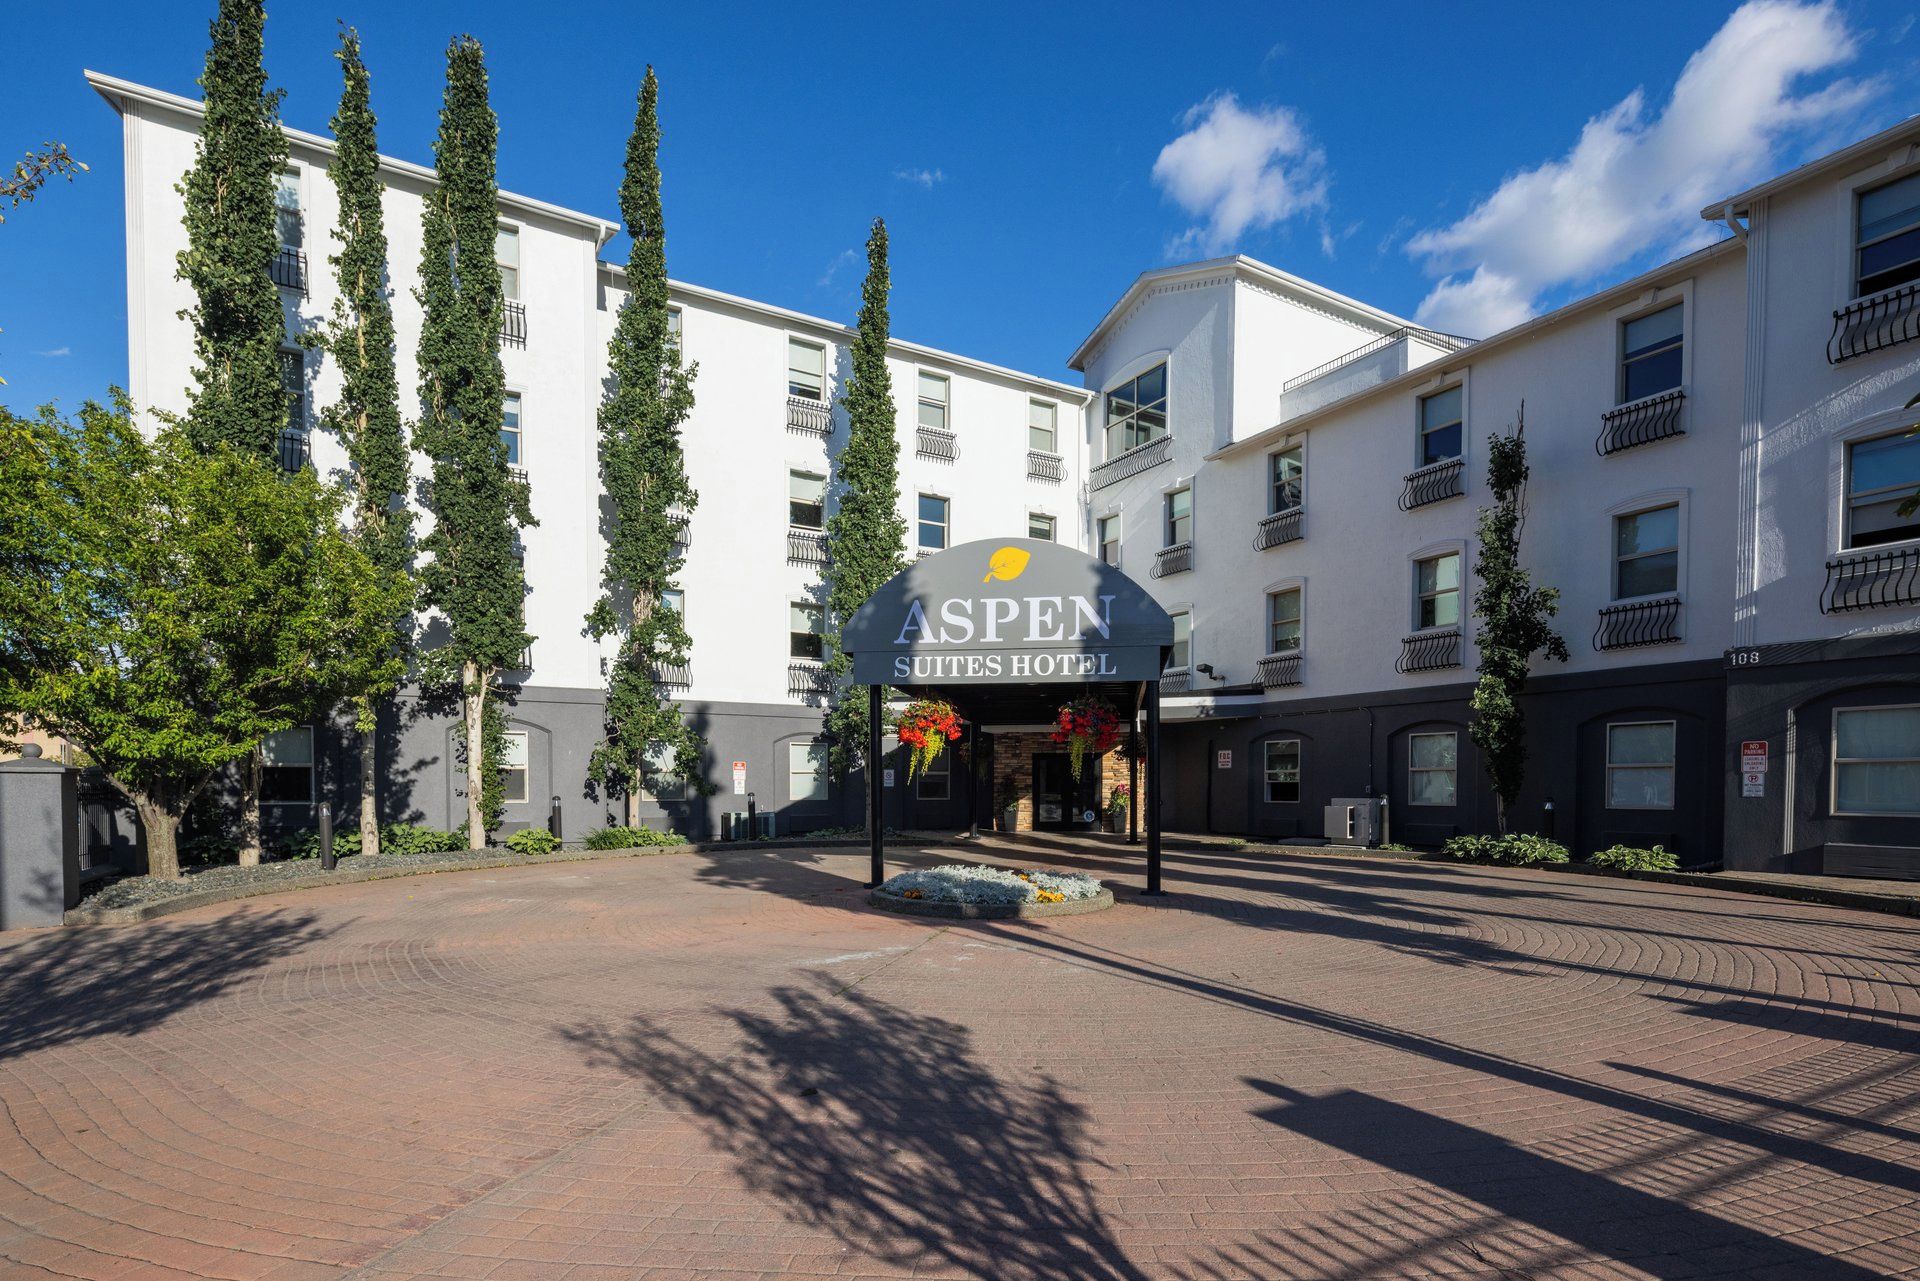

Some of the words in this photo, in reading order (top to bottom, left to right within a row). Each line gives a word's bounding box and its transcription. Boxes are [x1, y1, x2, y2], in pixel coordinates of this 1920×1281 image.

[894, 595, 1116, 644] ASPEN
[894, 655, 1003, 678] SUITES
[1010, 653, 1117, 677] HOTEL
[1730, 651, 1759, 666] 108
